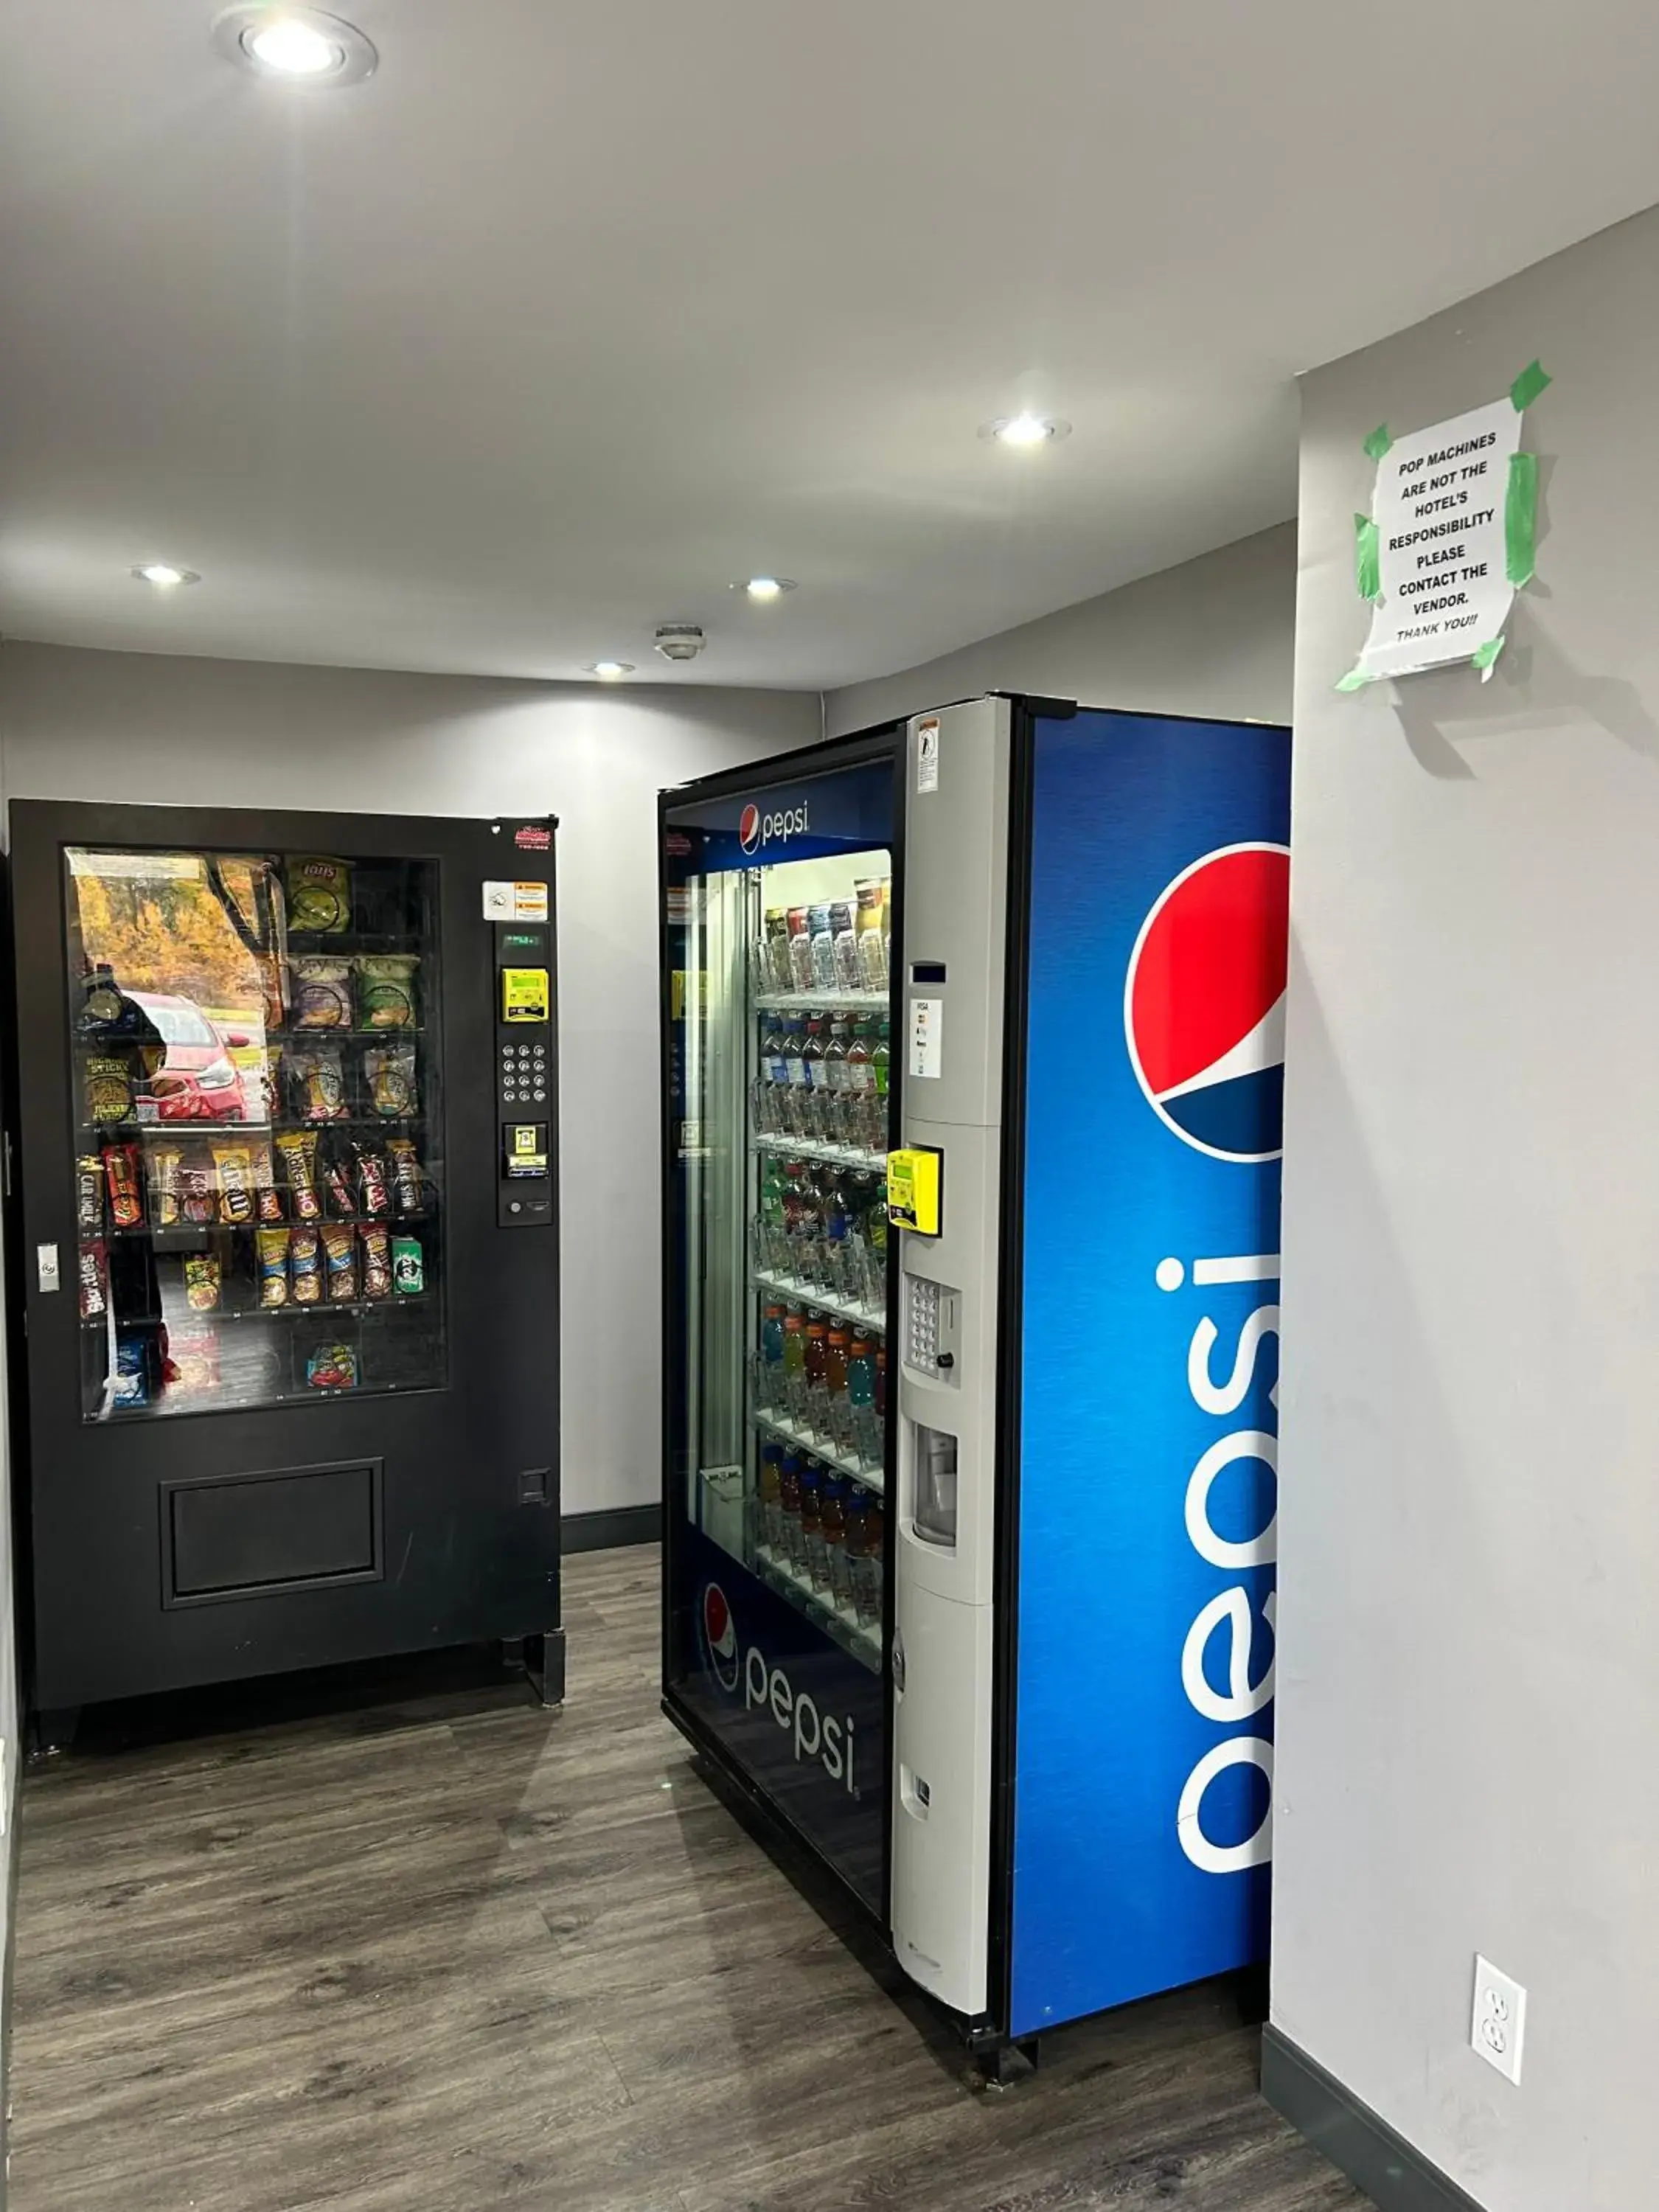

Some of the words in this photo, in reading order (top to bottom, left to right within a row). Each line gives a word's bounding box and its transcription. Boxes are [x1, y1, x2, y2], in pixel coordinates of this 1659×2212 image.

[1399, 457, 1424, 476] POP
[1427, 432, 1496, 466] MACHINES
[1401, 481, 1426, 500] ARE
[1430, 472, 1458, 491] NOT
[1460, 461, 1487, 481] THE
[1415, 491, 1469, 518] HOTEL'S
[1389, 509, 1495, 551] RESPONSIBILITY
[1416, 545, 1466, 569] PLEASE
[1399, 571, 1456, 597] CONTACT
[1460, 563, 1487, 582] THE
[1413, 591, 1469, 615] VENDOR.
[1397, 622, 1439, 641] THANK
[1444, 613, 1478, 632] YOU!!
[762, 799, 808, 846] pepsi
[745, 1646, 855, 1793] pepsi
